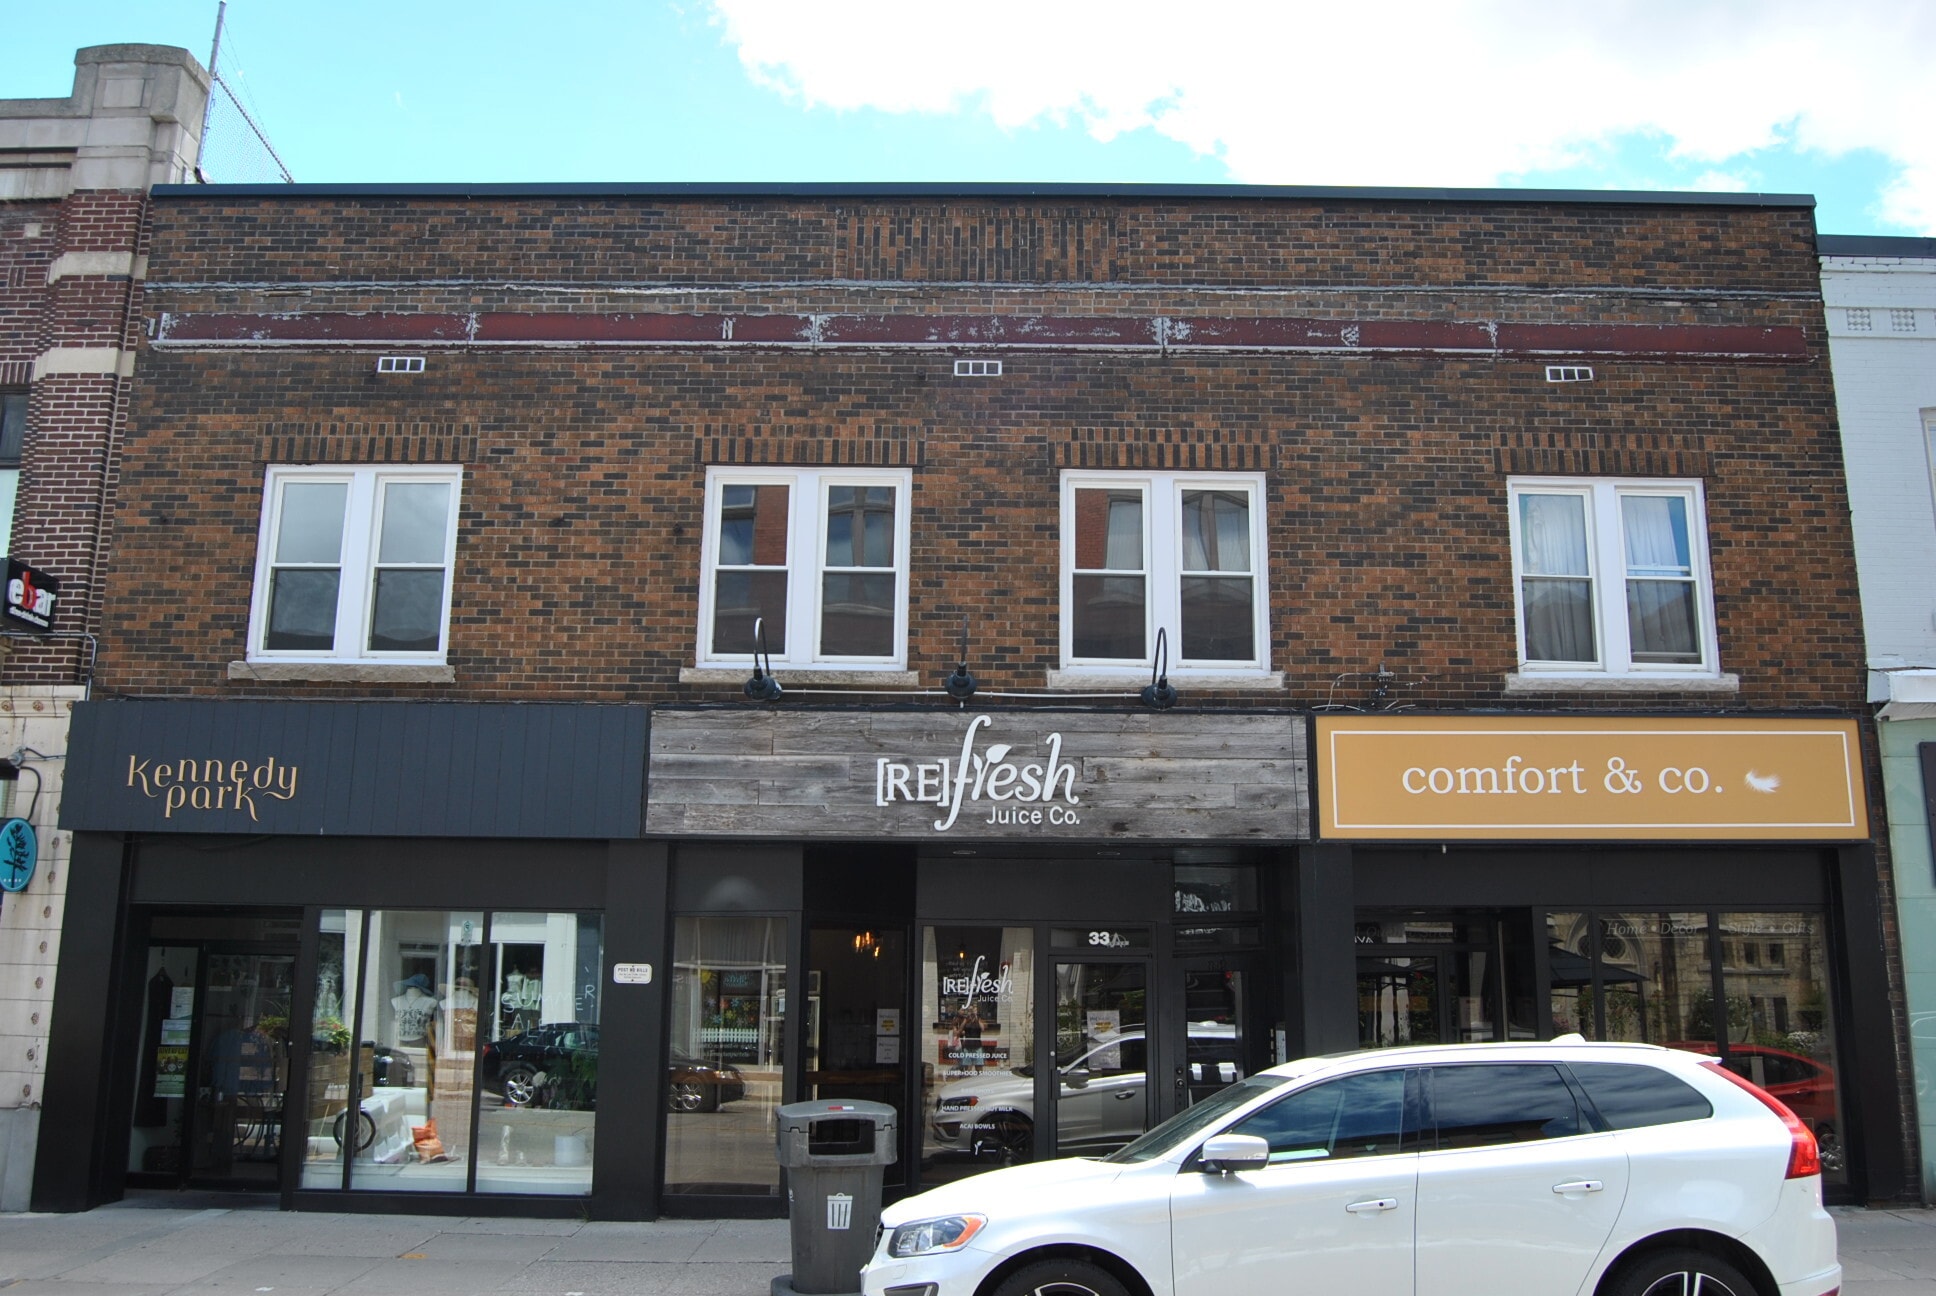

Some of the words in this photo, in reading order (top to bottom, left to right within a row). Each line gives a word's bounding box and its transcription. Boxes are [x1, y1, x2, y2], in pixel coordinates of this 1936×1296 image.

[9, 571, 57, 617] ebar
[1402, 755, 1587, 794] comfort
[1603, 756, 1643, 794] &
[1658, 766, 1724, 794] co.
[165, 777, 259, 822] park
[986, 806, 1043, 825] Juice
[1049, 806, 1080, 825] Co.
[1606, 922, 1648, 935] Home
[1727, 921, 1764, 937] Style
[1782, 921, 1815, 937] Gifts
[501, 985, 596, 1013] SUMMER
[977, 994, 999, 1003] Juice
